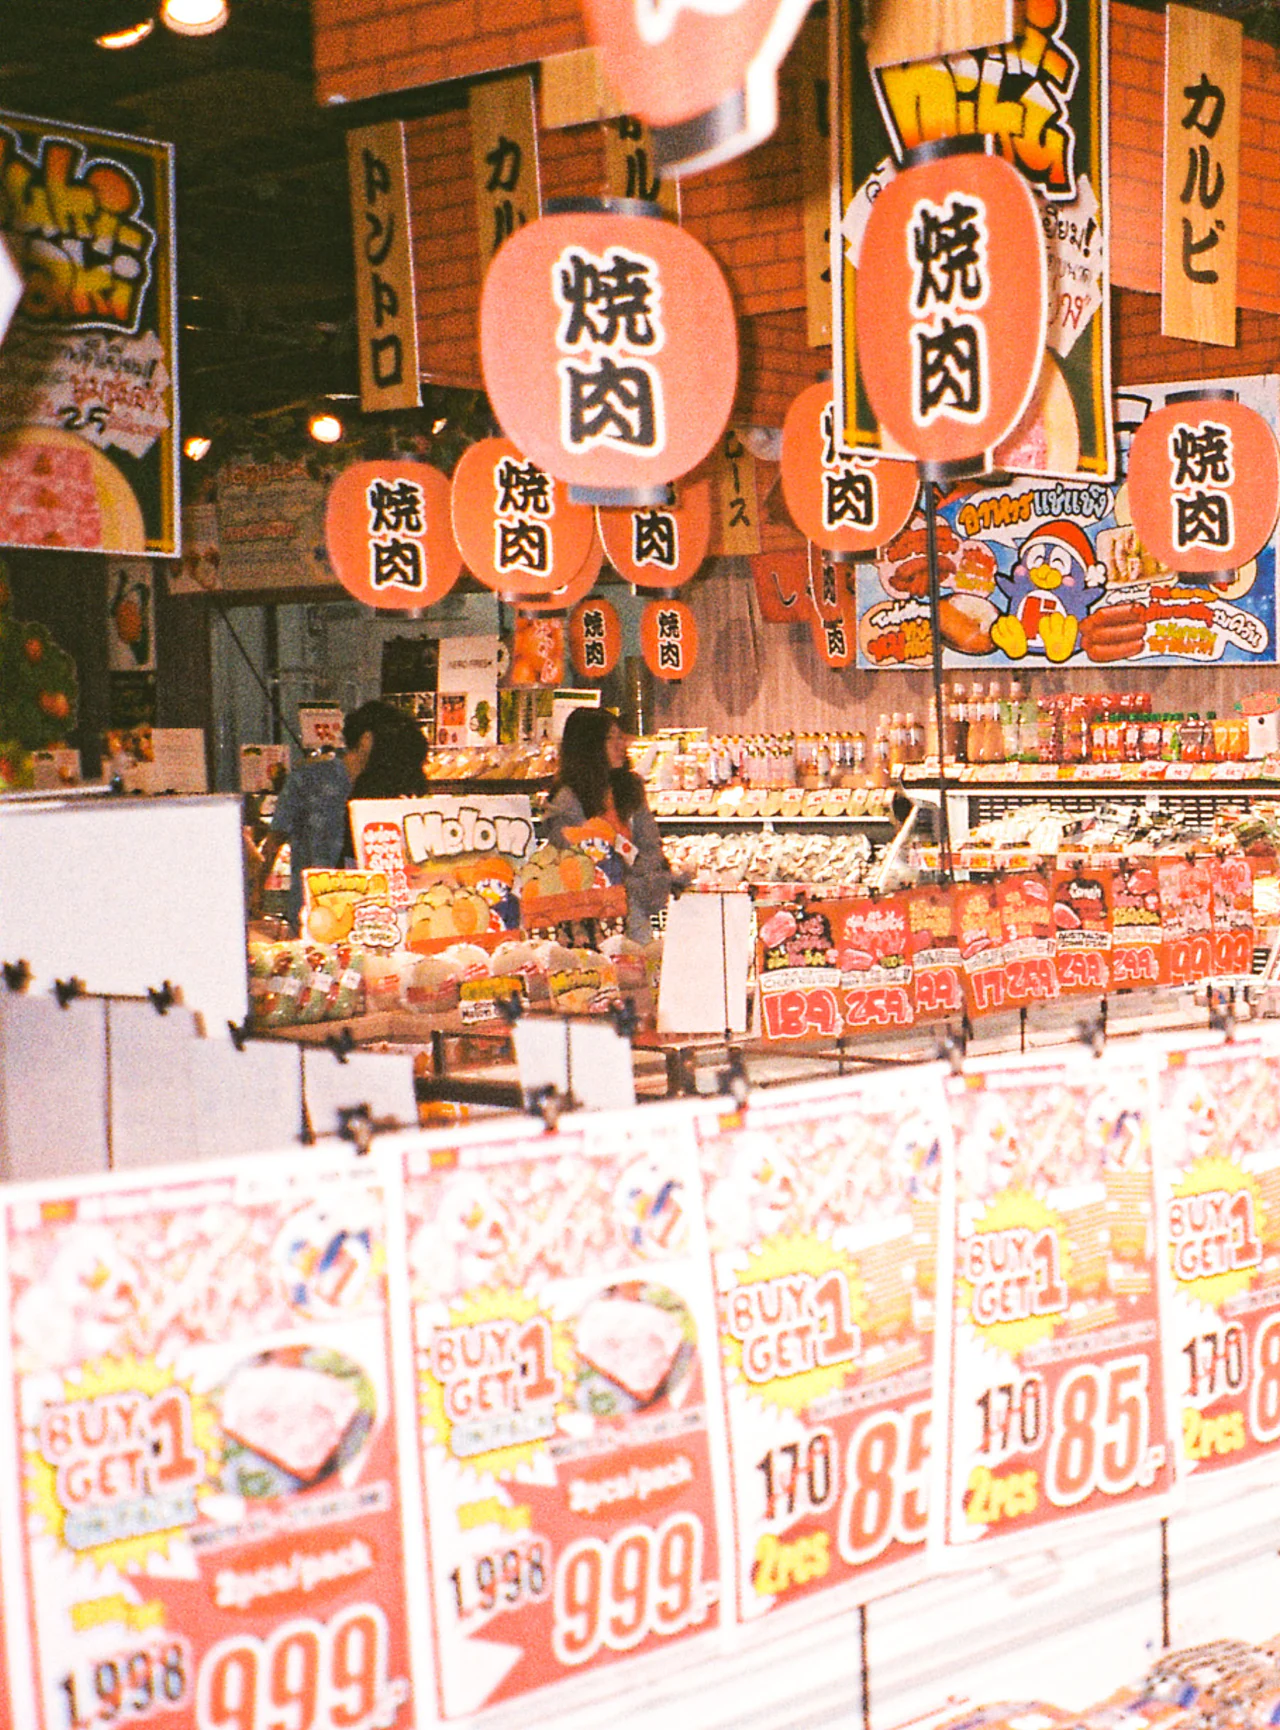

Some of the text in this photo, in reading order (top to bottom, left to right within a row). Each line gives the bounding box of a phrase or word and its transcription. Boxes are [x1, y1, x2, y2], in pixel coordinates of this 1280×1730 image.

[486, 135, 527, 250] カル
[1181, 72, 1226, 286] カルビ
[362, 148, 403, 390] トントロ
[913, 201, 984, 418] 焼肉
[562, 253, 660, 452] 焼肉
[499, 461, 551, 572] 焼肉
[958, 482, 1108, 536] อาหารแช่แข็ง
[1171, 425, 1230, 550] 焼肉
[370, 478, 426, 591] 焼肉
[633, 508, 676, 567] 肉
[582, 611, 606, 667] 焼肉
[656, 611, 683, 670] 焼肉
[402, 806, 533, 864] Melon
[1171, 1199, 1230, 1240] BUY
[969, 1235, 1030, 1280] BUY
[1178, 1235, 1232, 1277] GET
[732, 1286, 809, 1339] BUY
[978, 1277, 1033, 1322] GET
[435, 1329, 512, 1377] BUY
[747, 1327, 816, 1373] GET
[1182, 1325, 1244, 1398] 170
[451, 1368, 515, 1416] GET
[47, 1400, 141, 1449] BUY
[974, 1359, 1148, 1505] 170 85
[65, 1450, 143, 1504] GET
[560, 1520, 696, 1654] 999
[208, 1614, 379, 1730] 999
